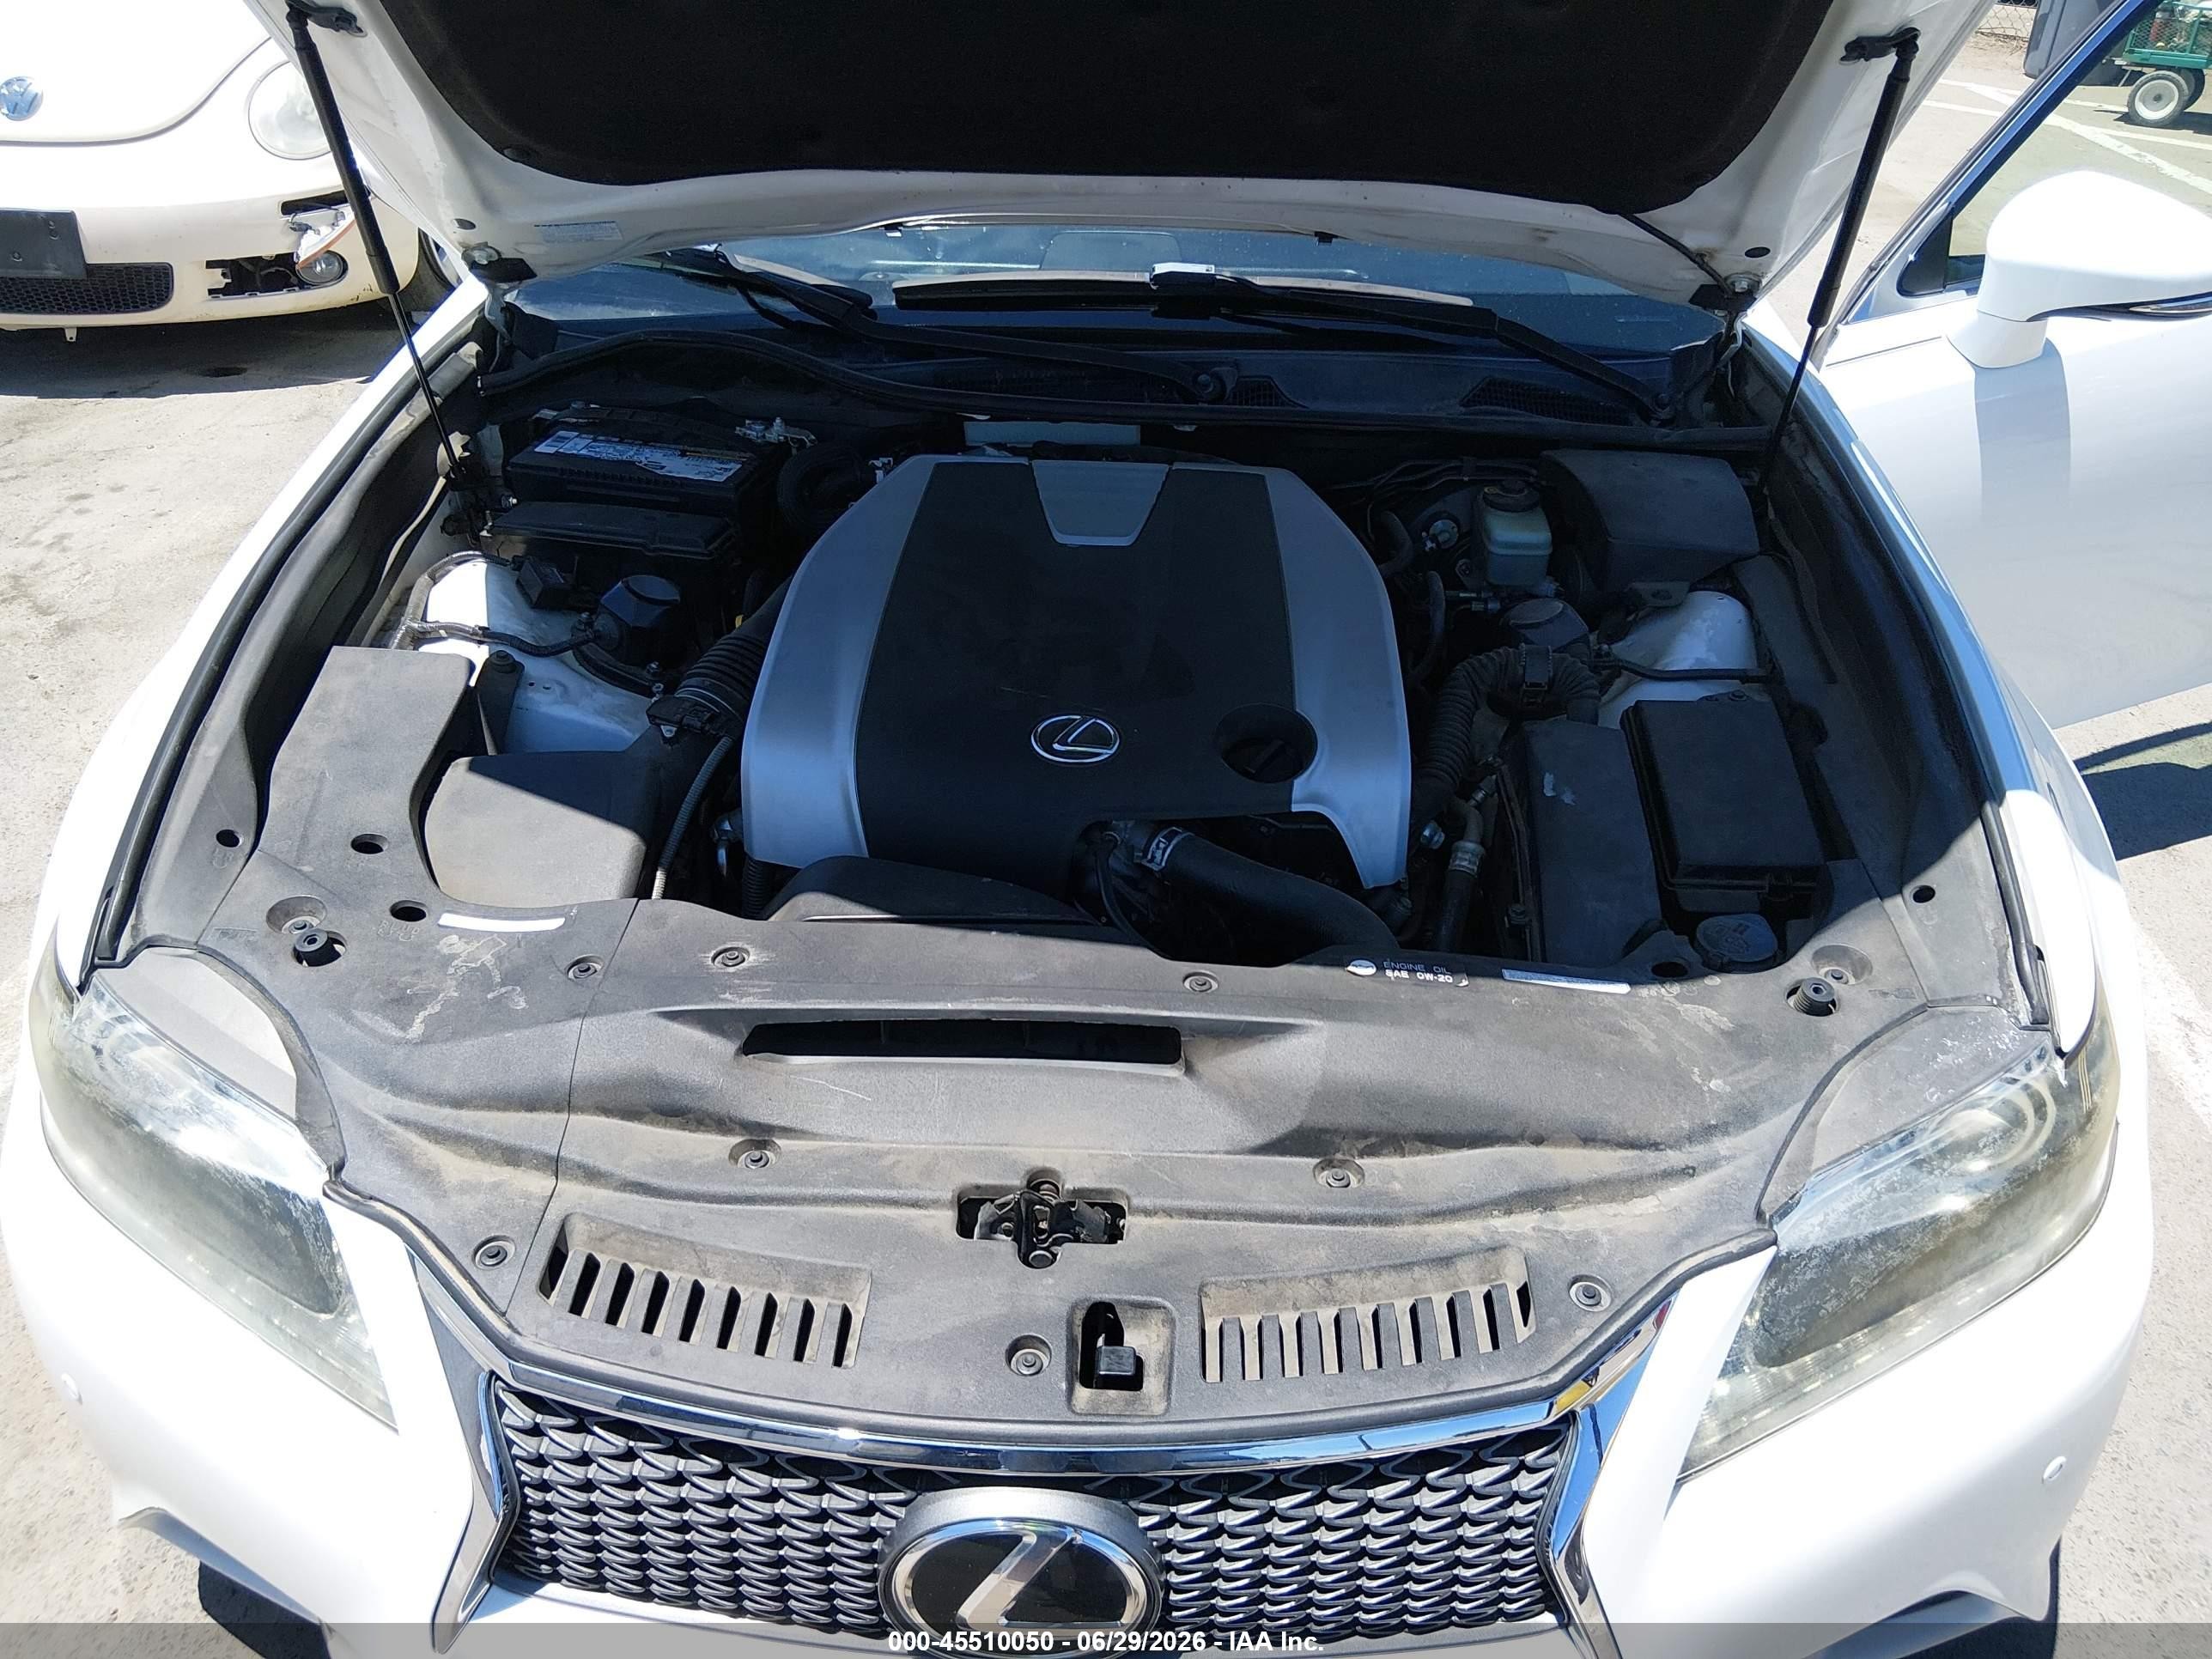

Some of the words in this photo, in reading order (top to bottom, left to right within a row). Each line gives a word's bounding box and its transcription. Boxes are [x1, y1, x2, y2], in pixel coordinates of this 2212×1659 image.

[1383, 961, 1425, 971] ENGINE
[1432, 966, 1452, 975] OIL
[1385, 969, 1409, 979] SAE
[1416, 971, 1453, 982] 0W-20
